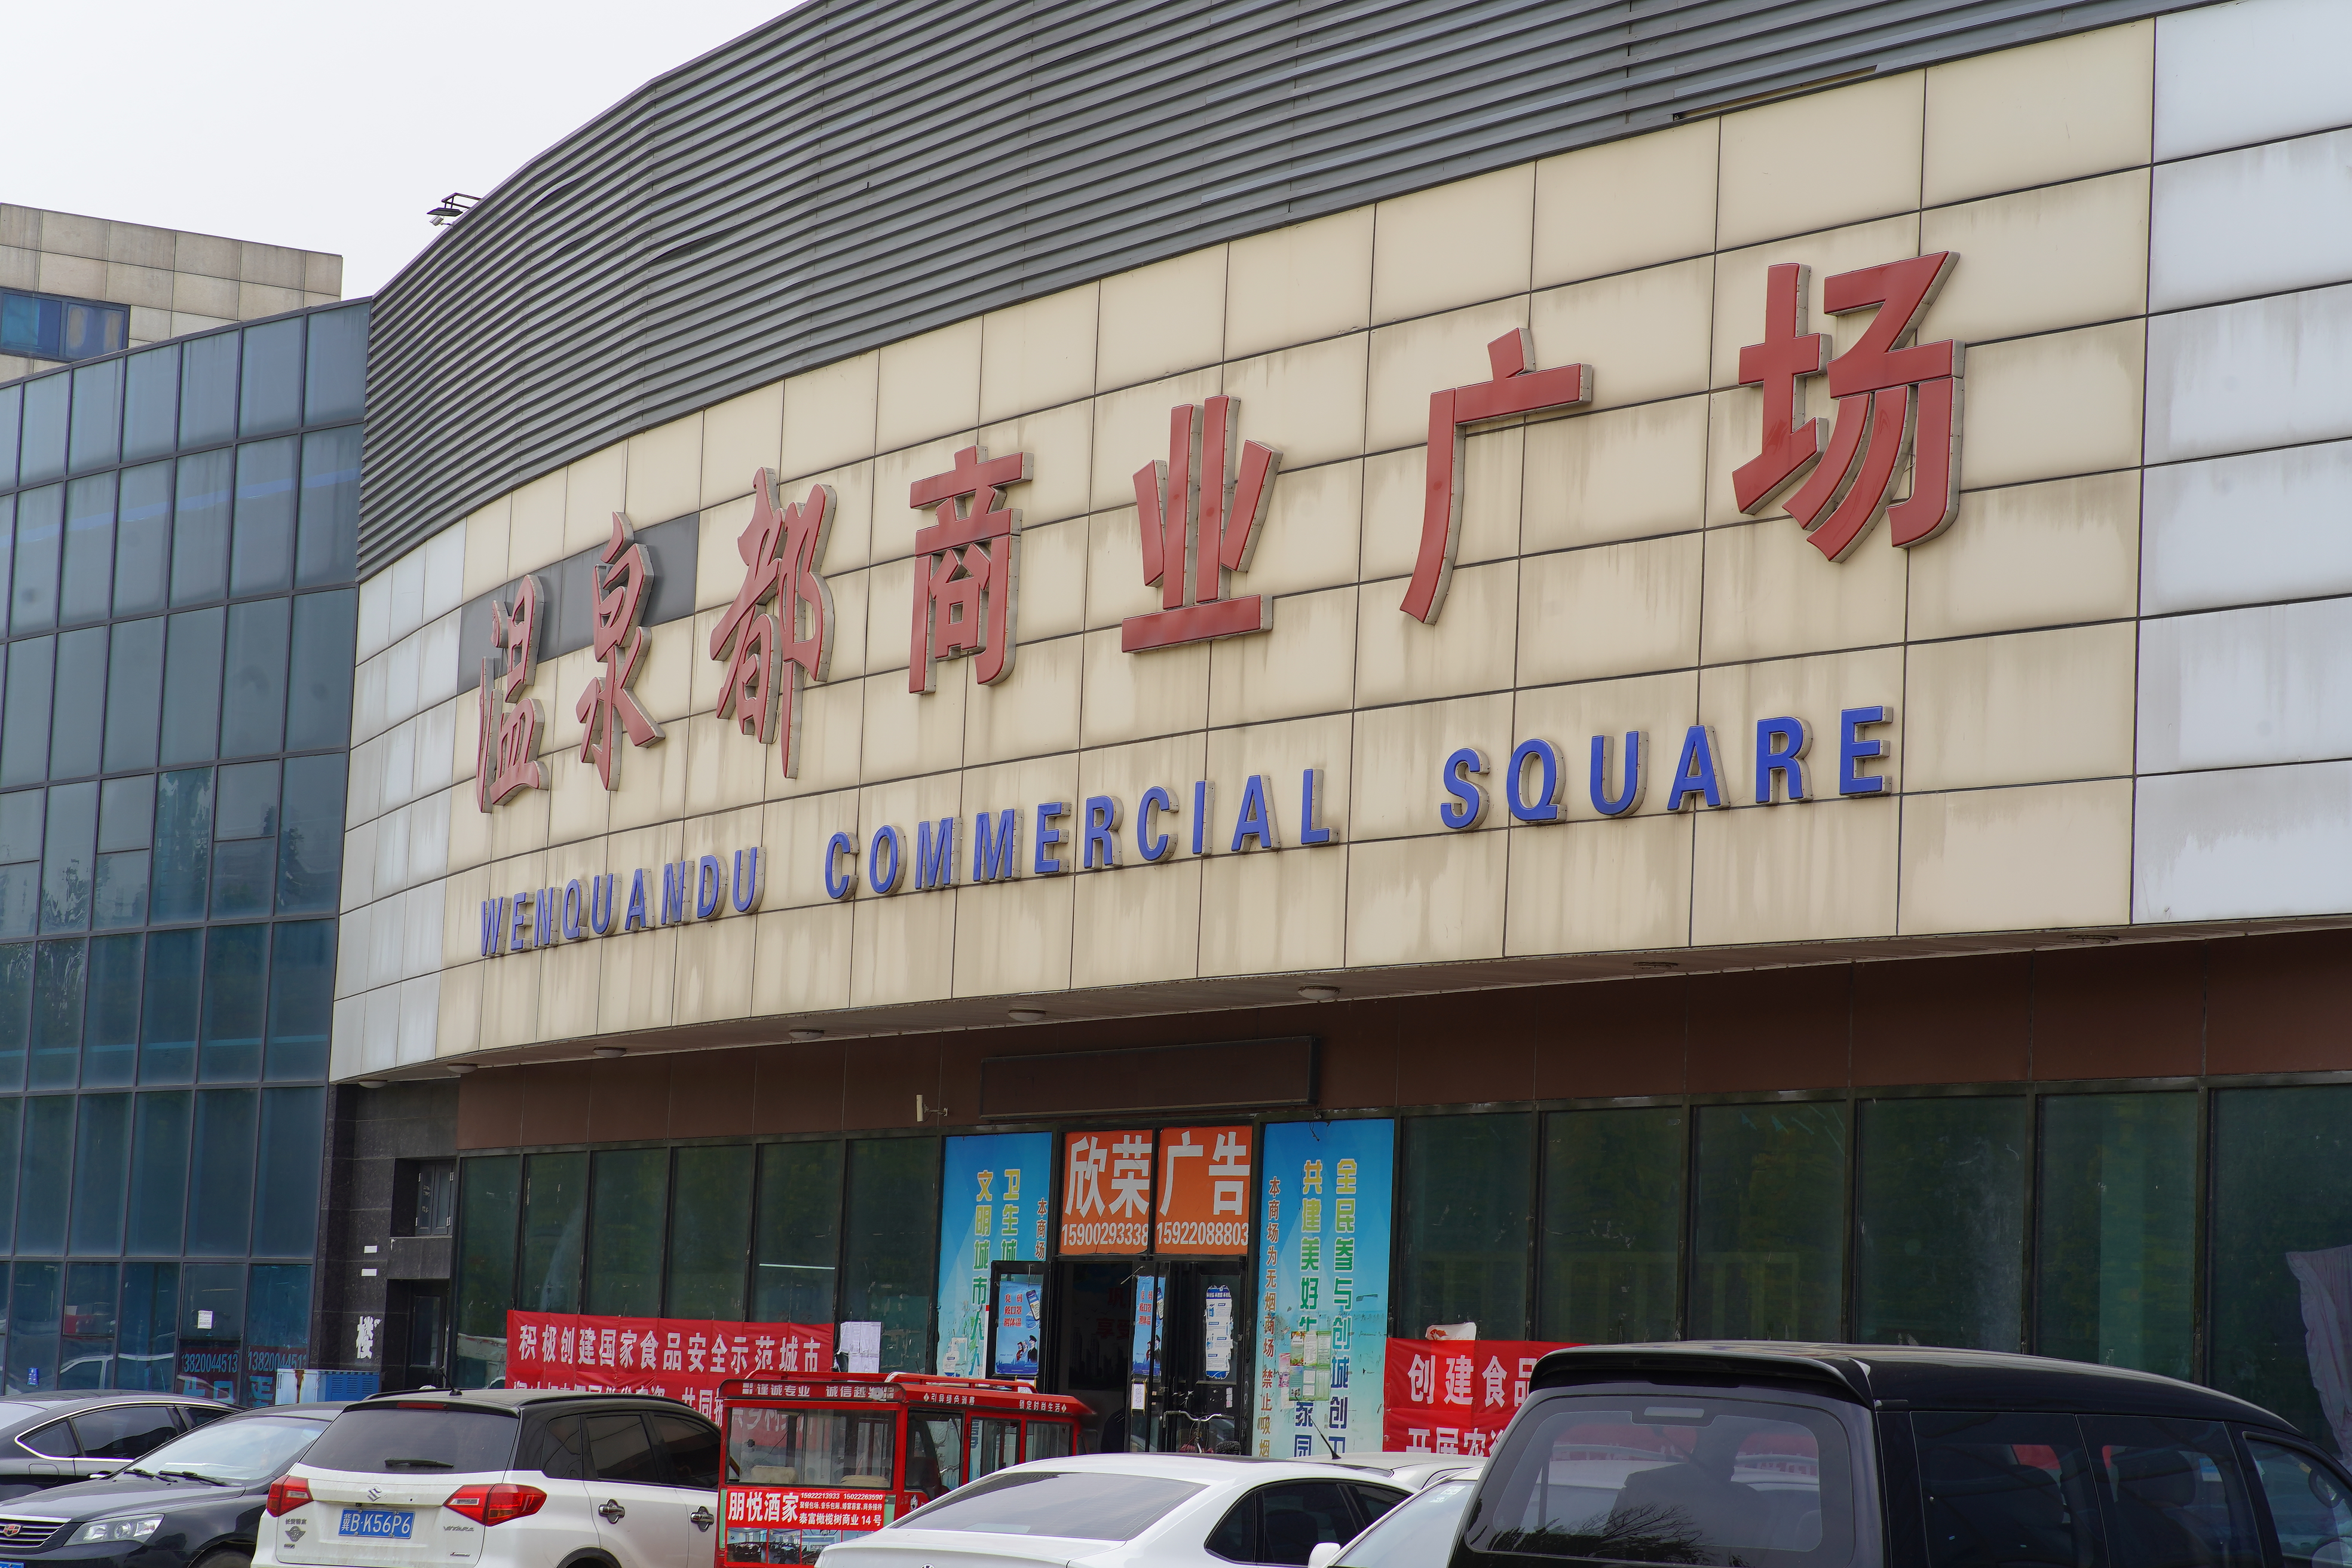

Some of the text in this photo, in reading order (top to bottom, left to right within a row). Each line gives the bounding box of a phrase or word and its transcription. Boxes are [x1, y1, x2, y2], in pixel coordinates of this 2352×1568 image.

[477, 250, 1965, 813] 温泉都商业广场
[480, 705, 1893, 956] WENQUANDU COMMERCIAL SQUARE
[1064, 1130, 1251, 1218] 欣荣广告
[1061, 1221, 1249, 1247] 15900293338 15922088803
[181, 1353, 238, 1373] 13820044513
[518, 1324, 821, 1374] 积极创建国家食品安全示范城市
[930, 1393, 1061, 1413] 引导绿色消费 锁定时尚生活
[727, 1492, 800, 1523] 朋悦酒家
[799, 1512, 882, 1526] 泰富橄榄树商业 14 号
